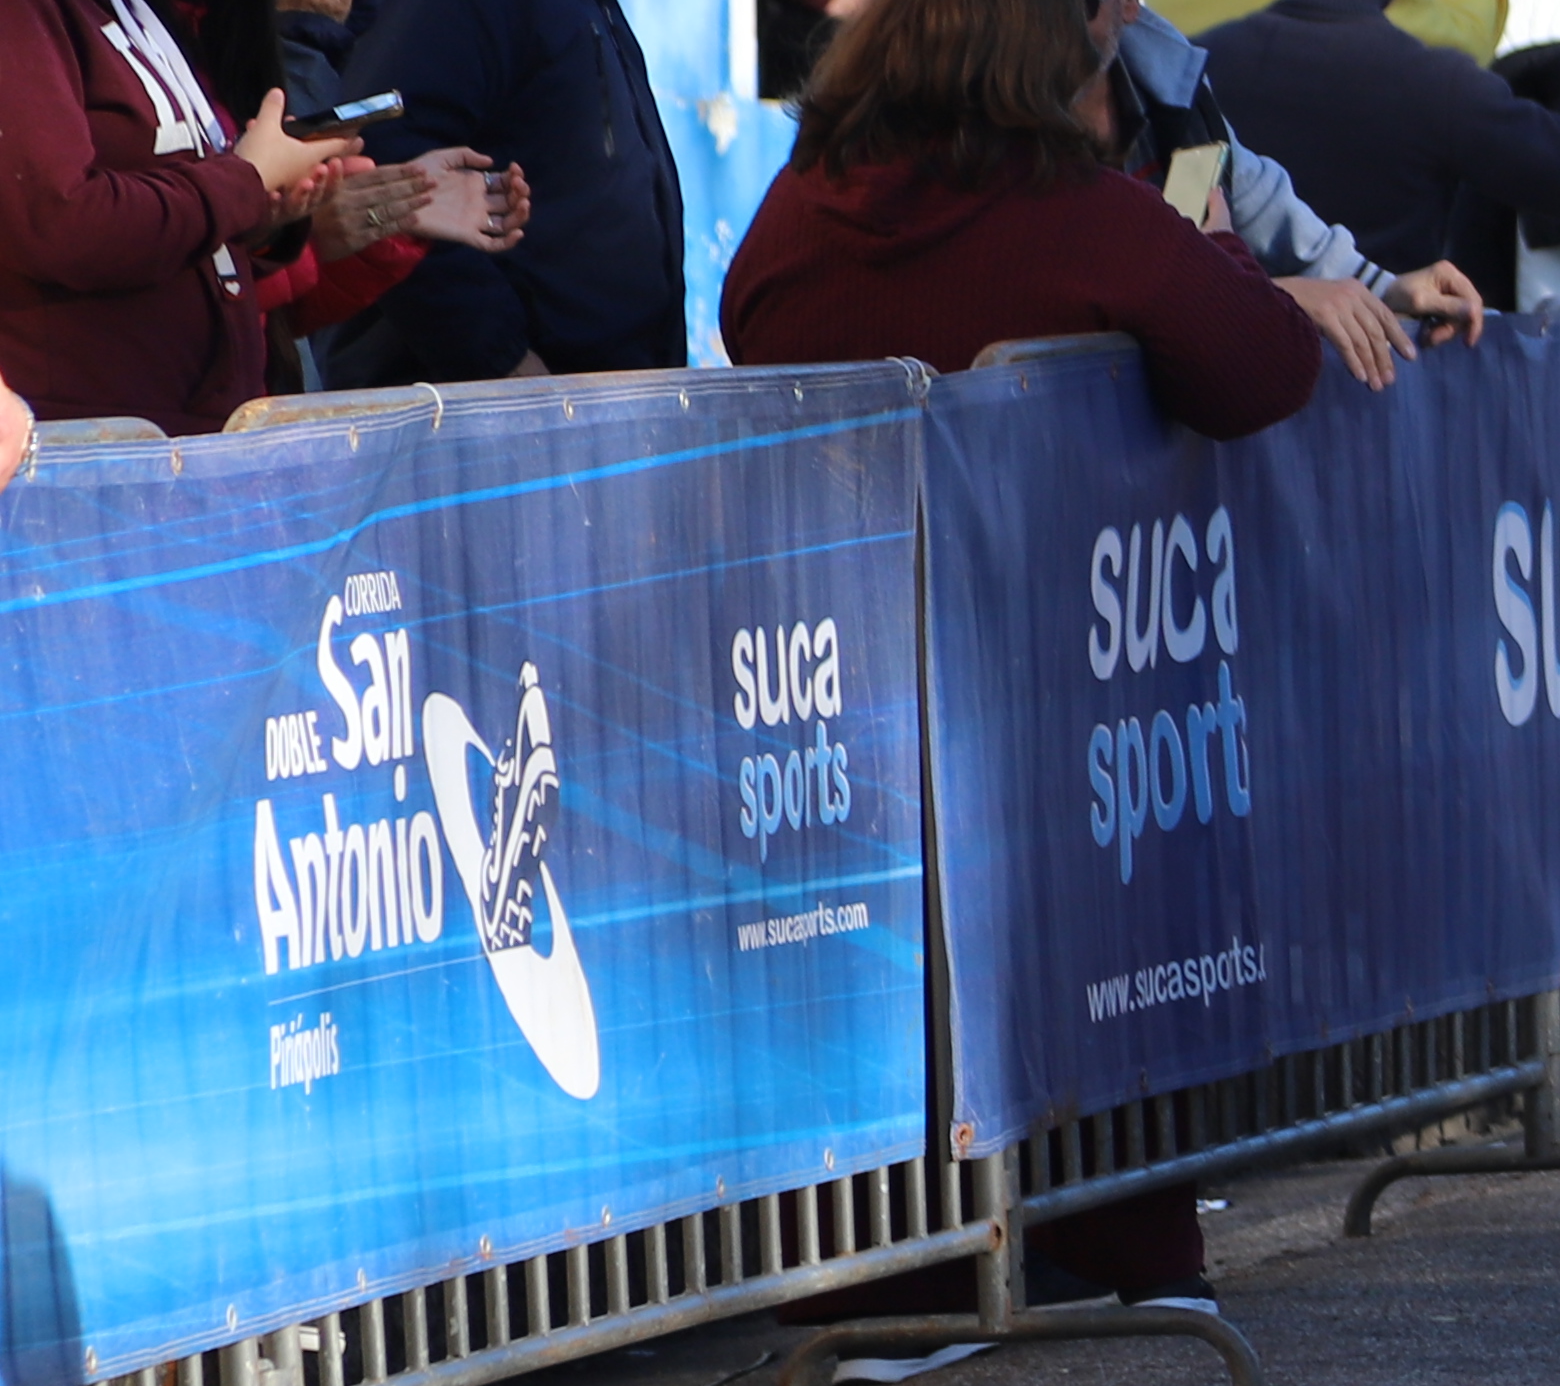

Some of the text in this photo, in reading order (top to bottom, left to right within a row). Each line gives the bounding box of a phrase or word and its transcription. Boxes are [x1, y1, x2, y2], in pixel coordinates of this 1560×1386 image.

[345, 570, 401, 616] CORRIDA
[1088, 504, 1238, 680] suca
[265, 594, 414, 781] DOBLE San
[731, 616, 842, 730] suca
[739, 719, 851, 864] sports
[1088, 659, 1251, 885] sport
[254, 764, 443, 975] Antonio
[270, 1012, 339, 1095] Piriápolis
